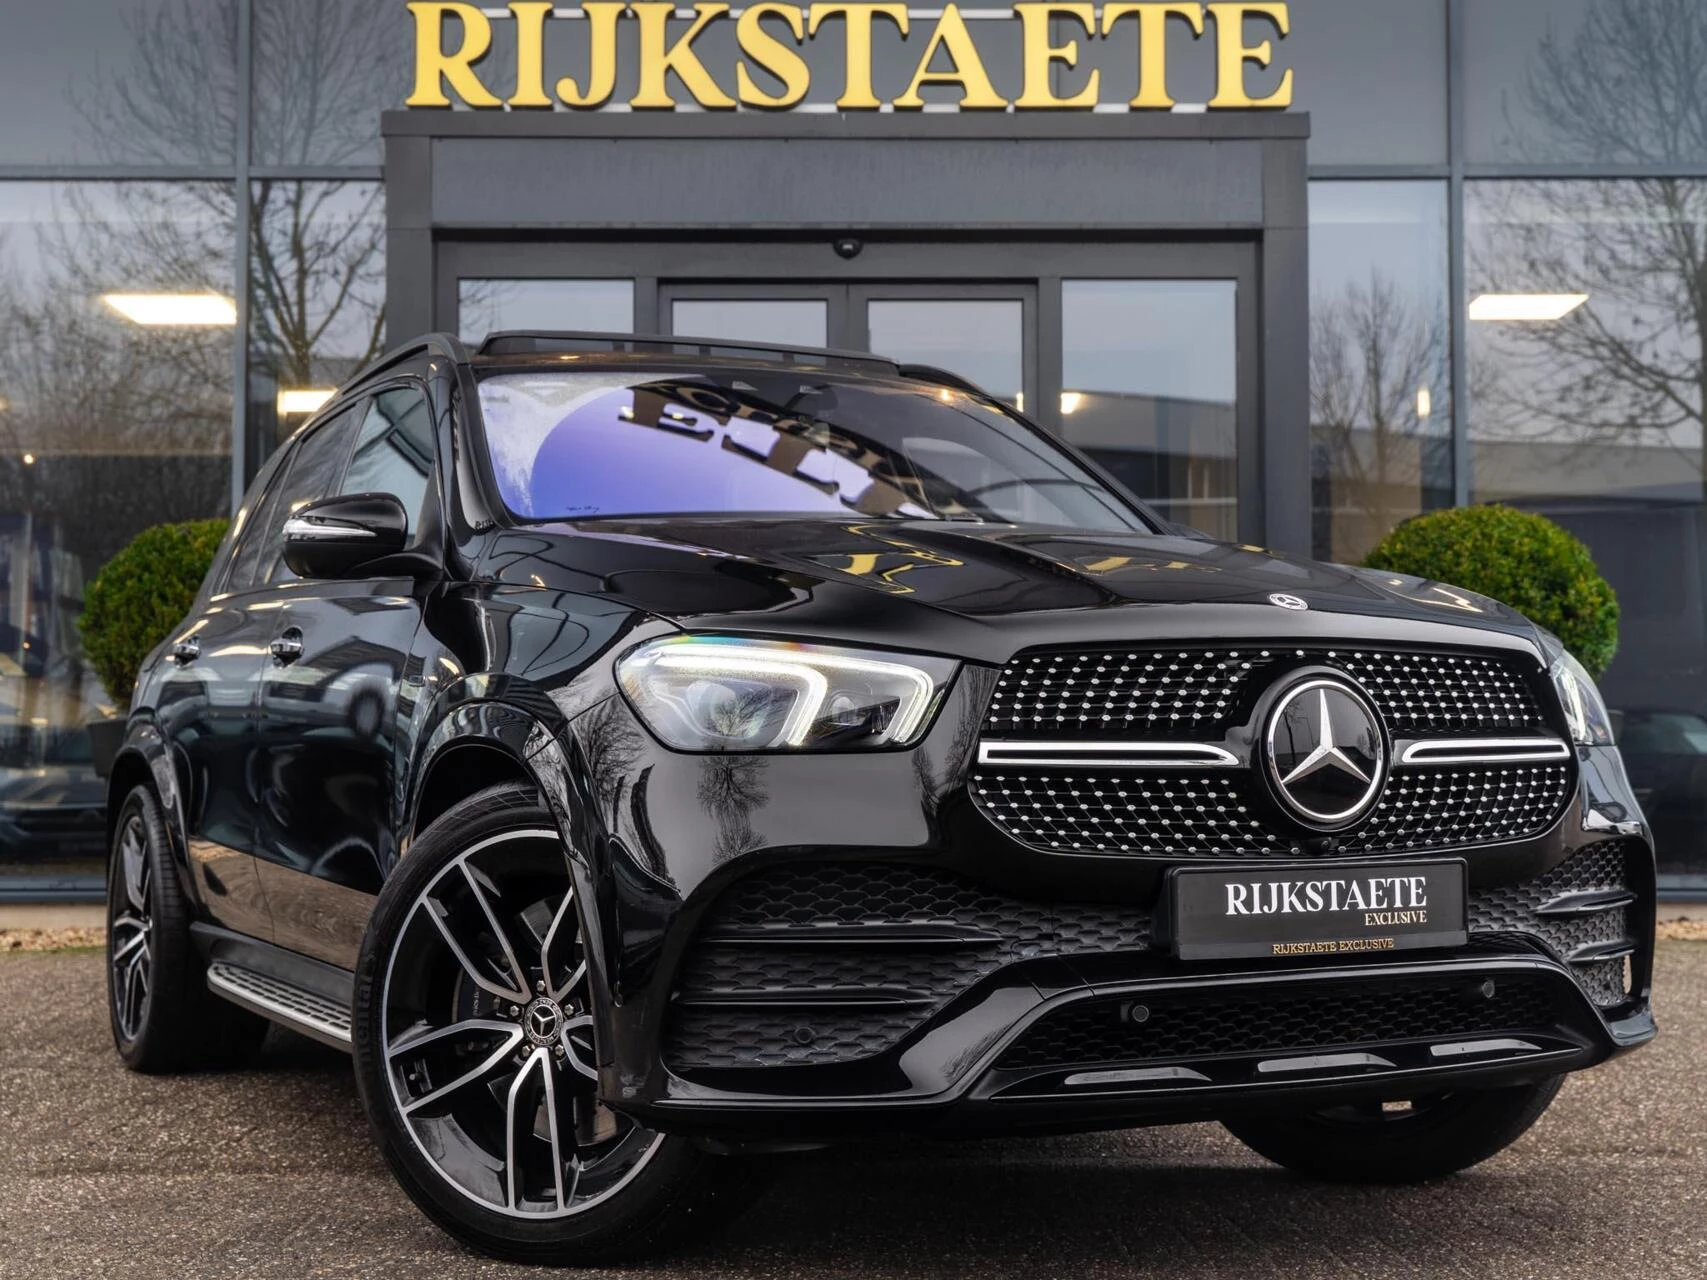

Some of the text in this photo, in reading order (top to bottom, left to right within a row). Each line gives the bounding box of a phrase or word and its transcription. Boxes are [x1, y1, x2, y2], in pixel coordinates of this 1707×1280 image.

[404, 1, 1294, 111] RIJKSTAETE
[1225, 877, 1428, 915] RIJKSTAETE
[1364, 910, 1428, 926] EXCLUSIVE
[1272, 938, 1395, 955] RIJKSTAETE EXCLUSIVE
